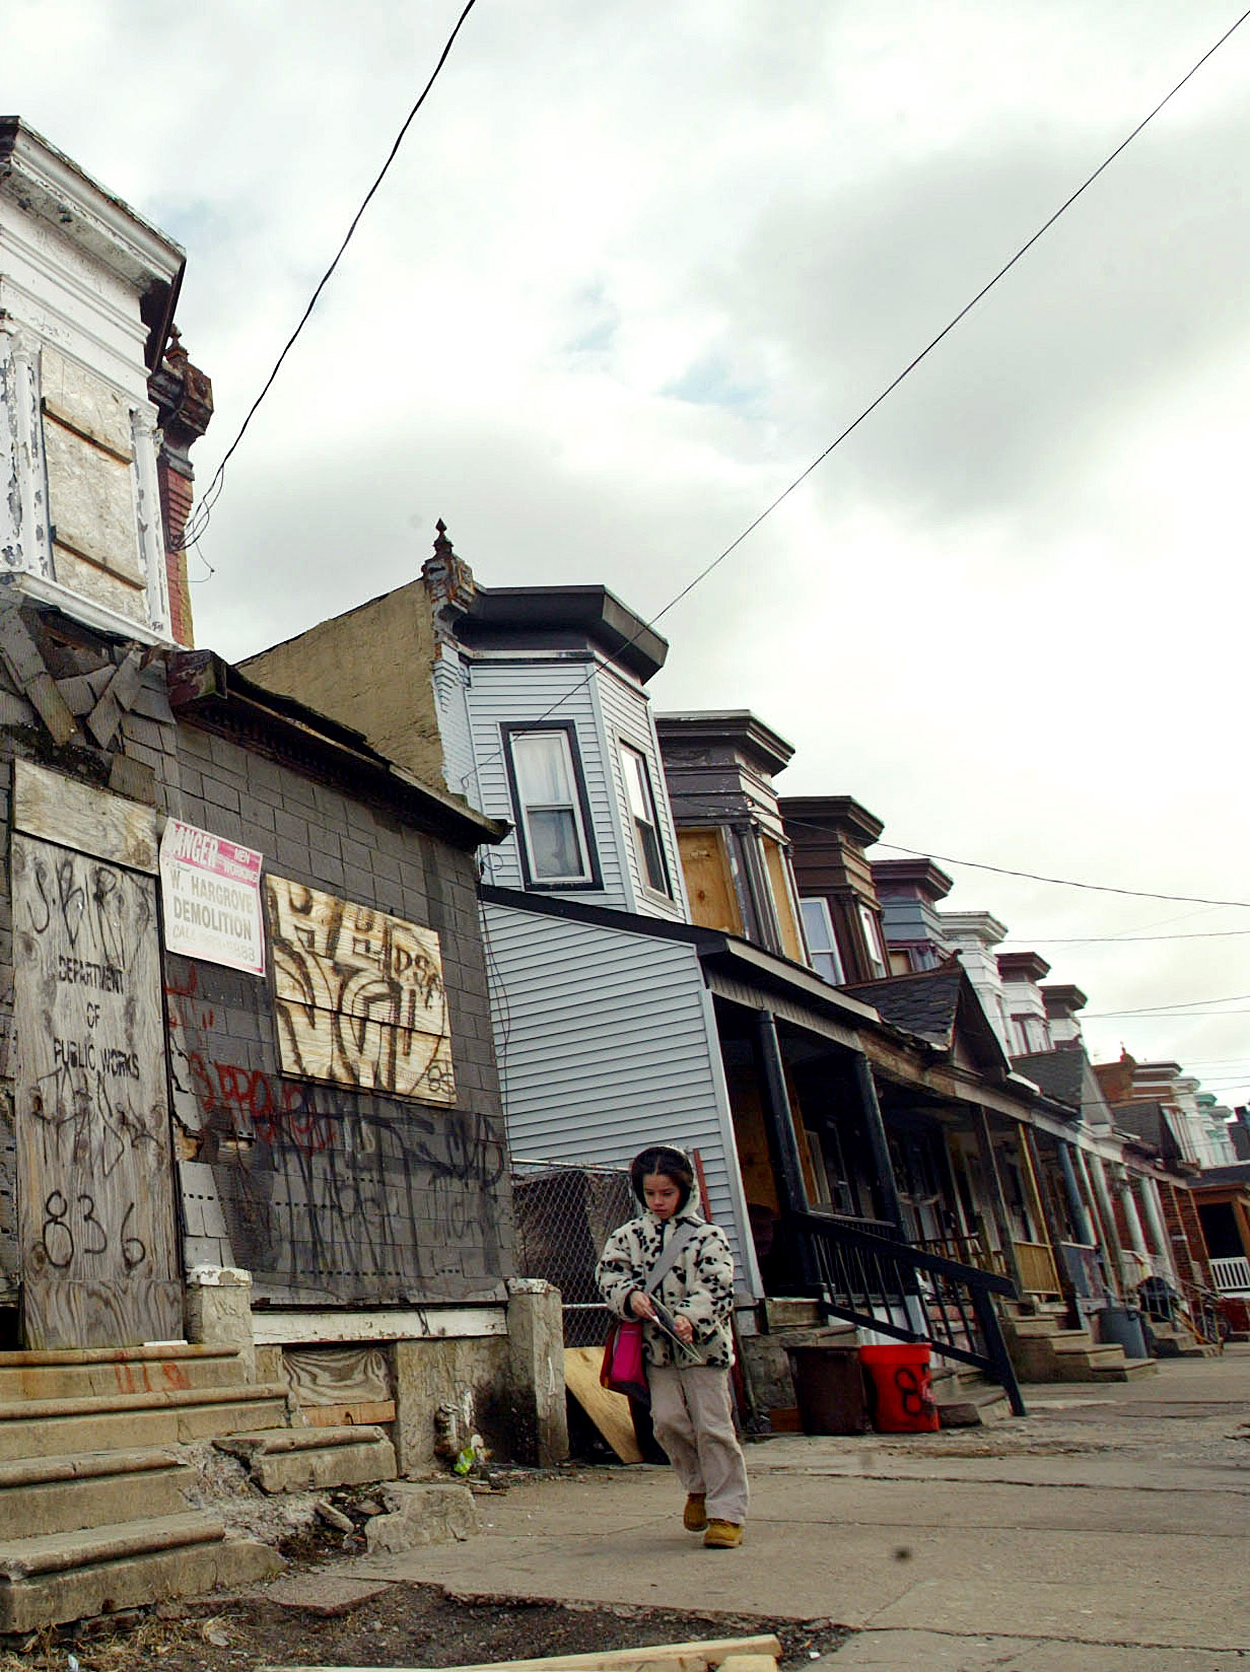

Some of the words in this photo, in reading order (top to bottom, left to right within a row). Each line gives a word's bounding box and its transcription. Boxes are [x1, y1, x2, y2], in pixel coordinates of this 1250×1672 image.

[171, 870, 184, 892] W.
[191, 875, 254, 914] HARGROVE
[173, 896, 252, 941] DEMOLITION
[59, 954, 124, 995] DEPARTMENT
[86, 1002, 100, 1028] OF
[54, 1037, 95, 1070] PUBLIC
[101, 1048, 139, 1080] WORKS
[43, 1190, 145, 1269] 836
